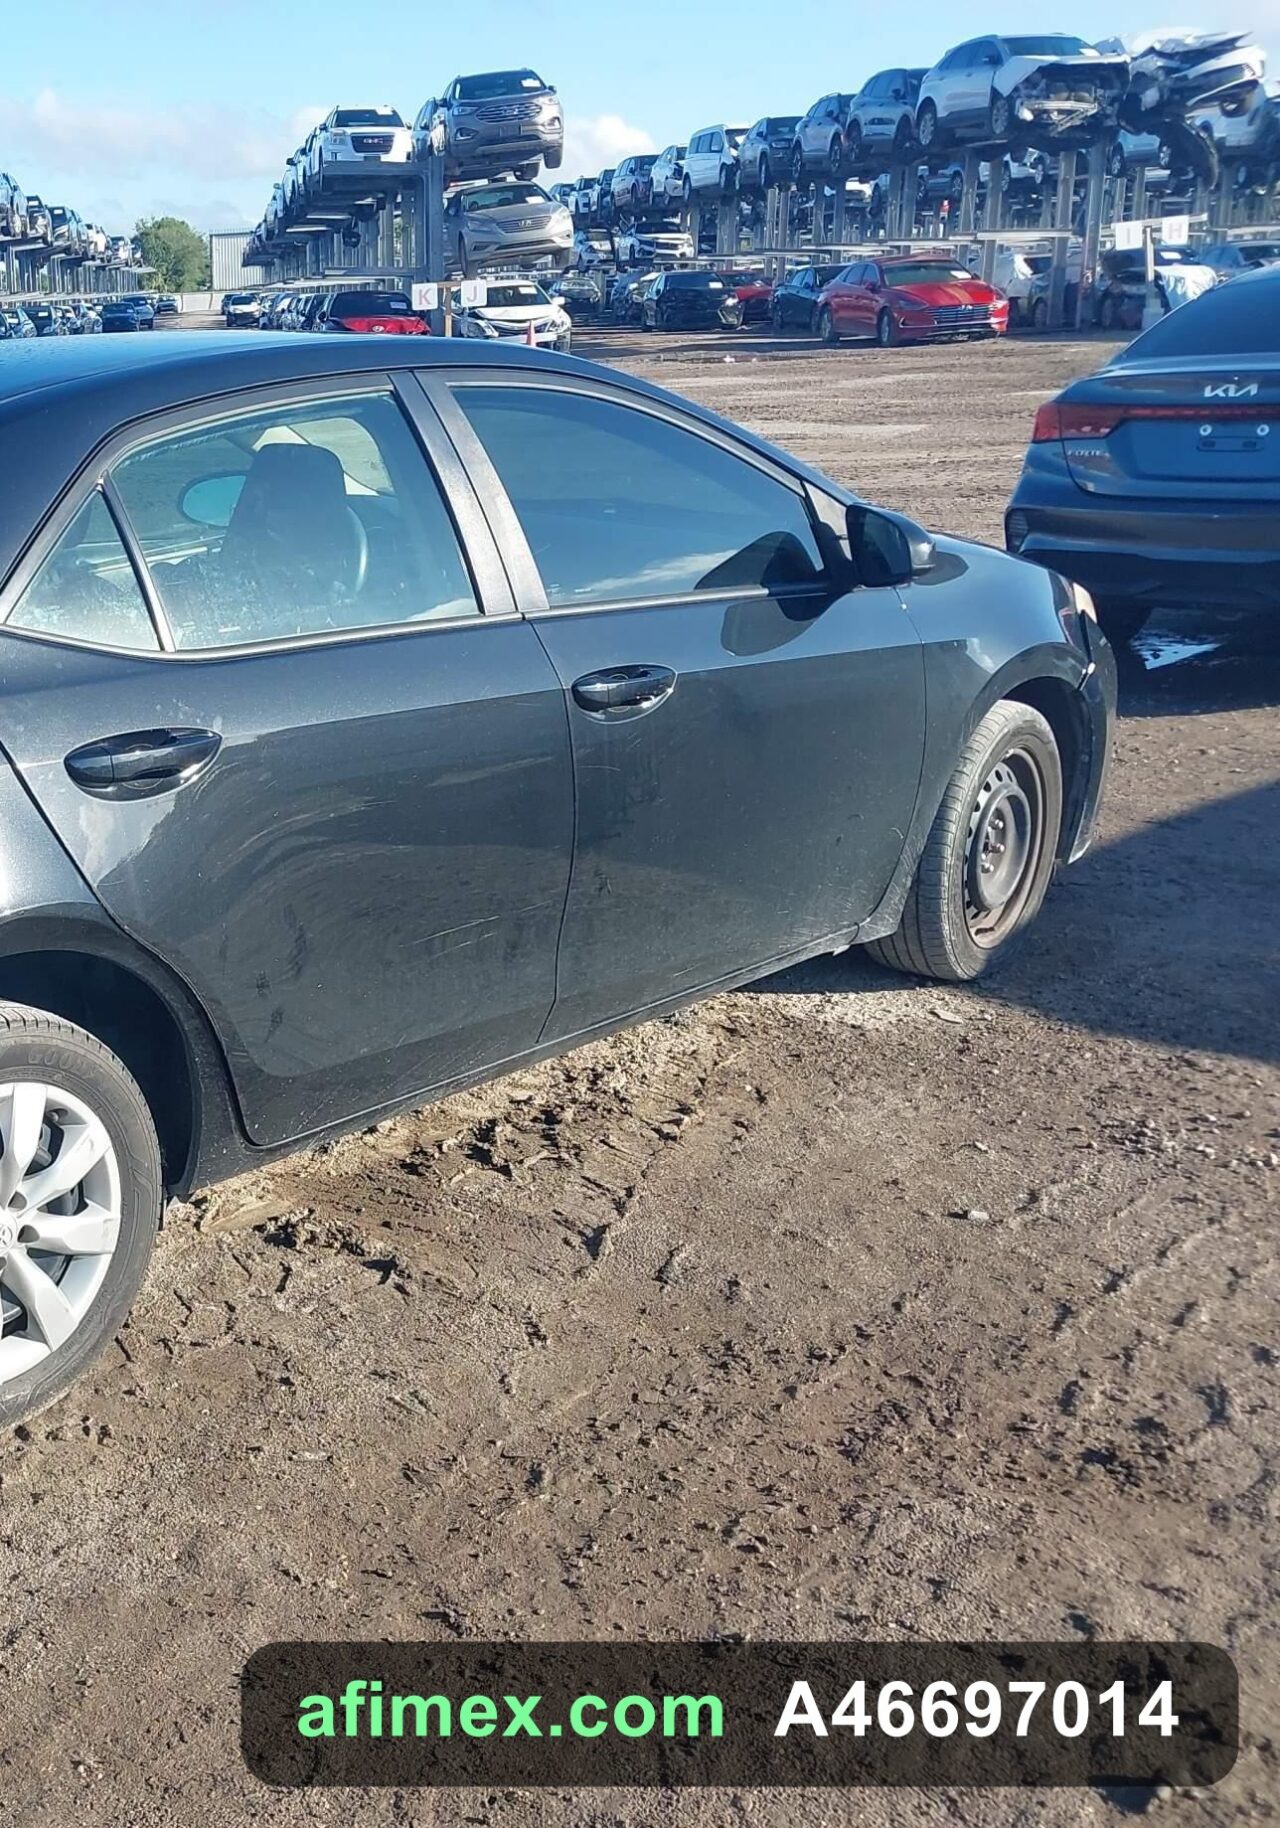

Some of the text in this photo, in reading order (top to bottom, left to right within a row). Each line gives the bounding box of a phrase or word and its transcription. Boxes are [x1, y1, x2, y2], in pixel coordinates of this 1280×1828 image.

[1168, 222, 1183, 240] H
[418, 287, 432, 306] K
[466, 285, 478, 303] J
[1204, 383, 1258, 397] KIA
